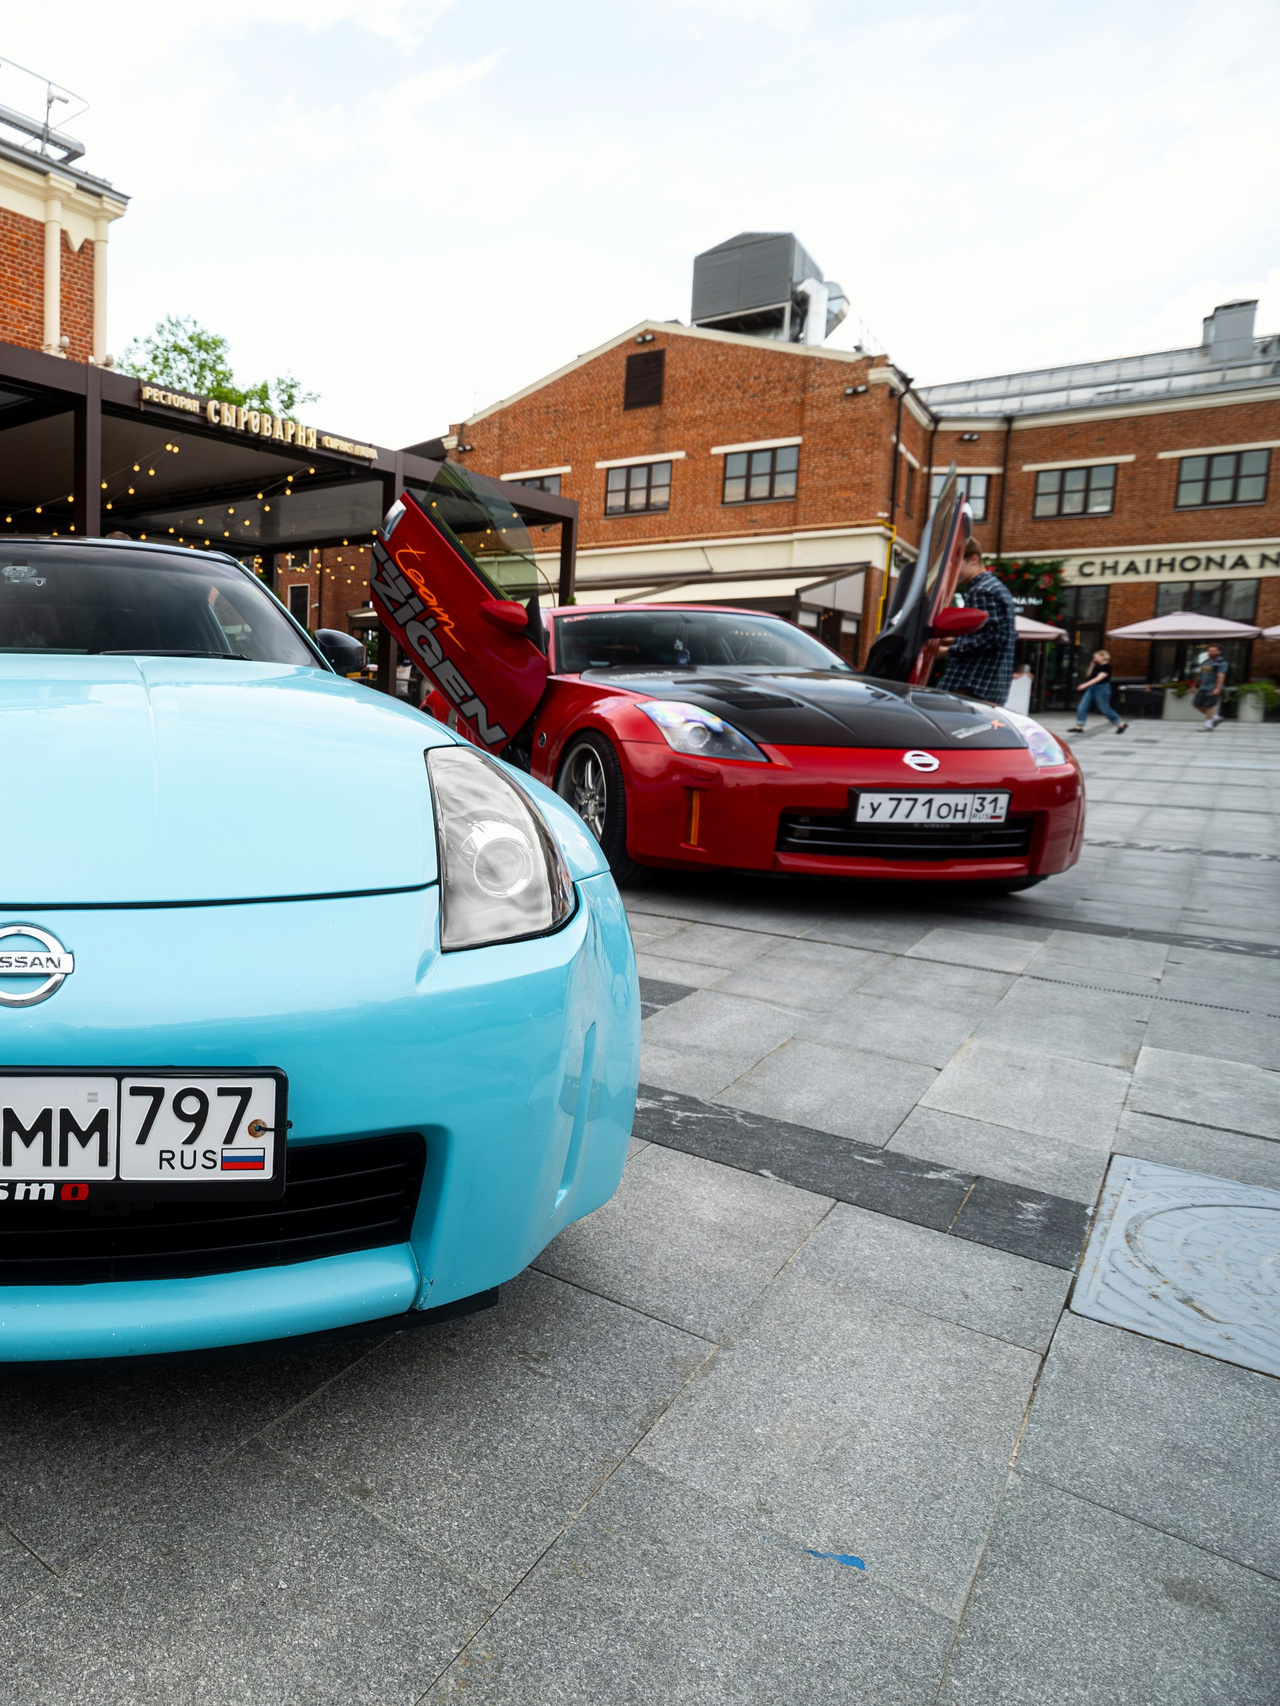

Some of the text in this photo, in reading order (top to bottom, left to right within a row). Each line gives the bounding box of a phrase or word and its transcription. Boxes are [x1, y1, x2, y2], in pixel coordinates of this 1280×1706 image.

[142, 386, 200, 413] РЕСТОРАН
[207, 399, 317, 449] СЫРОВАРНЯ
[1078, 553, 1250, 577] CHAIHONA
[974, 796, 999, 814] 31
[129, 1086, 253, 1145] 797
[159, 1149, 217, 1170] RUS
